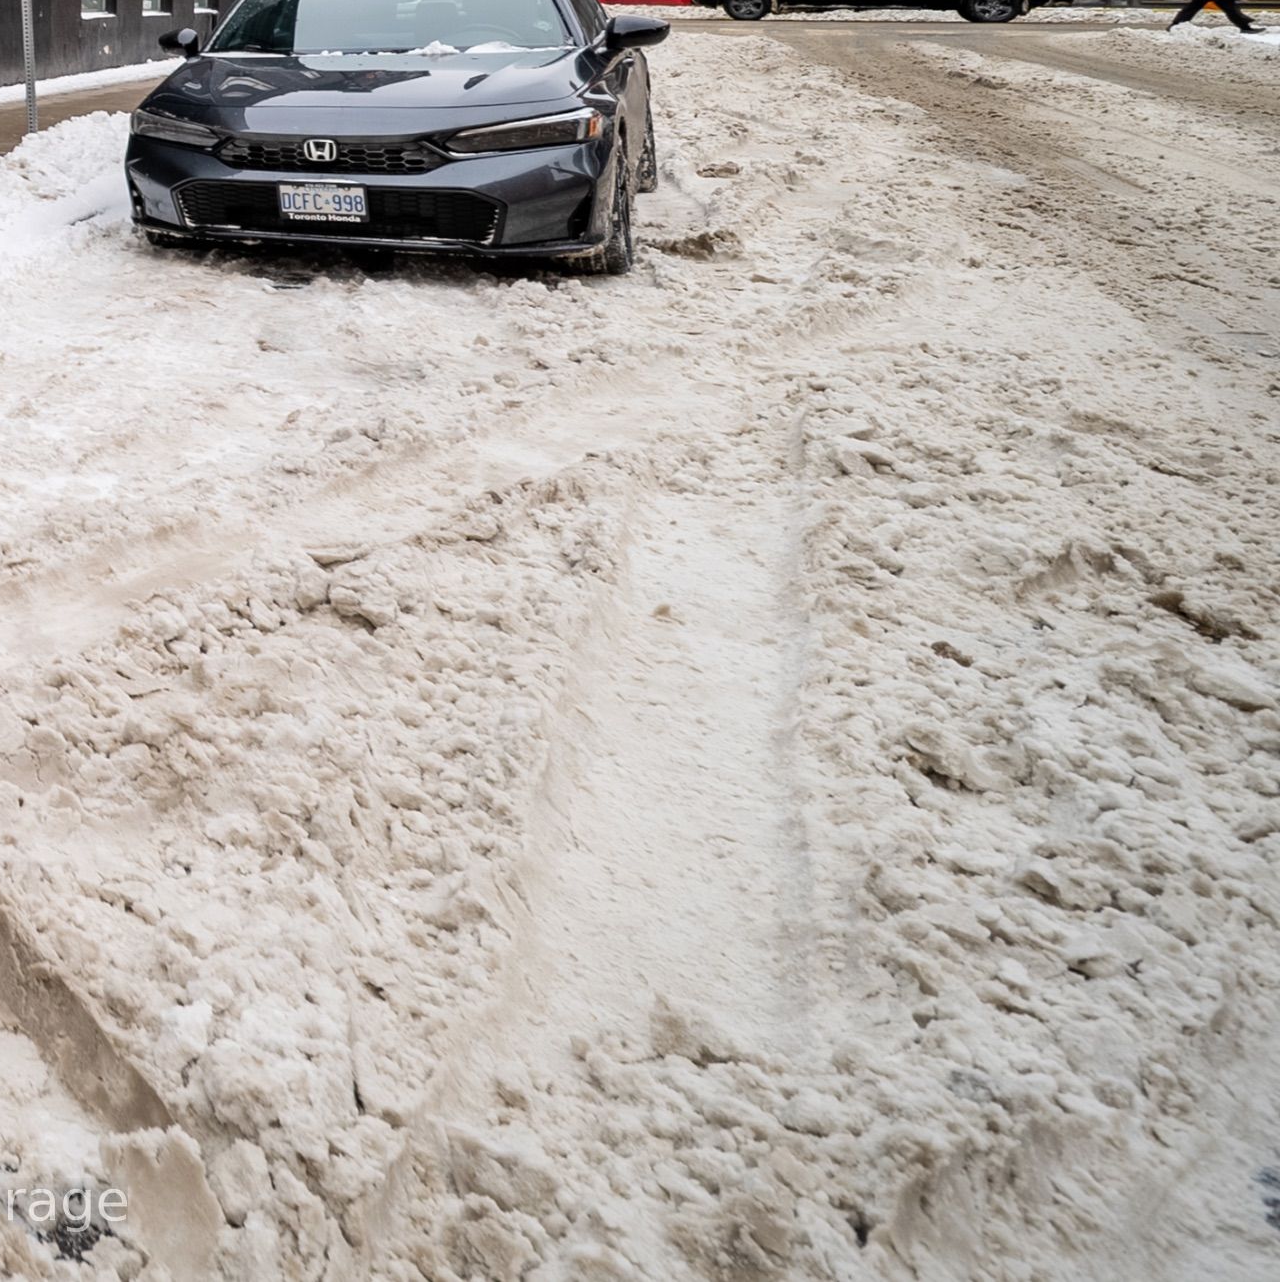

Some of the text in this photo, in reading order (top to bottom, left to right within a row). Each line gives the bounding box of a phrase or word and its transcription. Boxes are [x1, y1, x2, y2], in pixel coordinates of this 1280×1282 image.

[332, 194, 365, 213] 998
[288, 212, 361, 223] Toronto Honda
